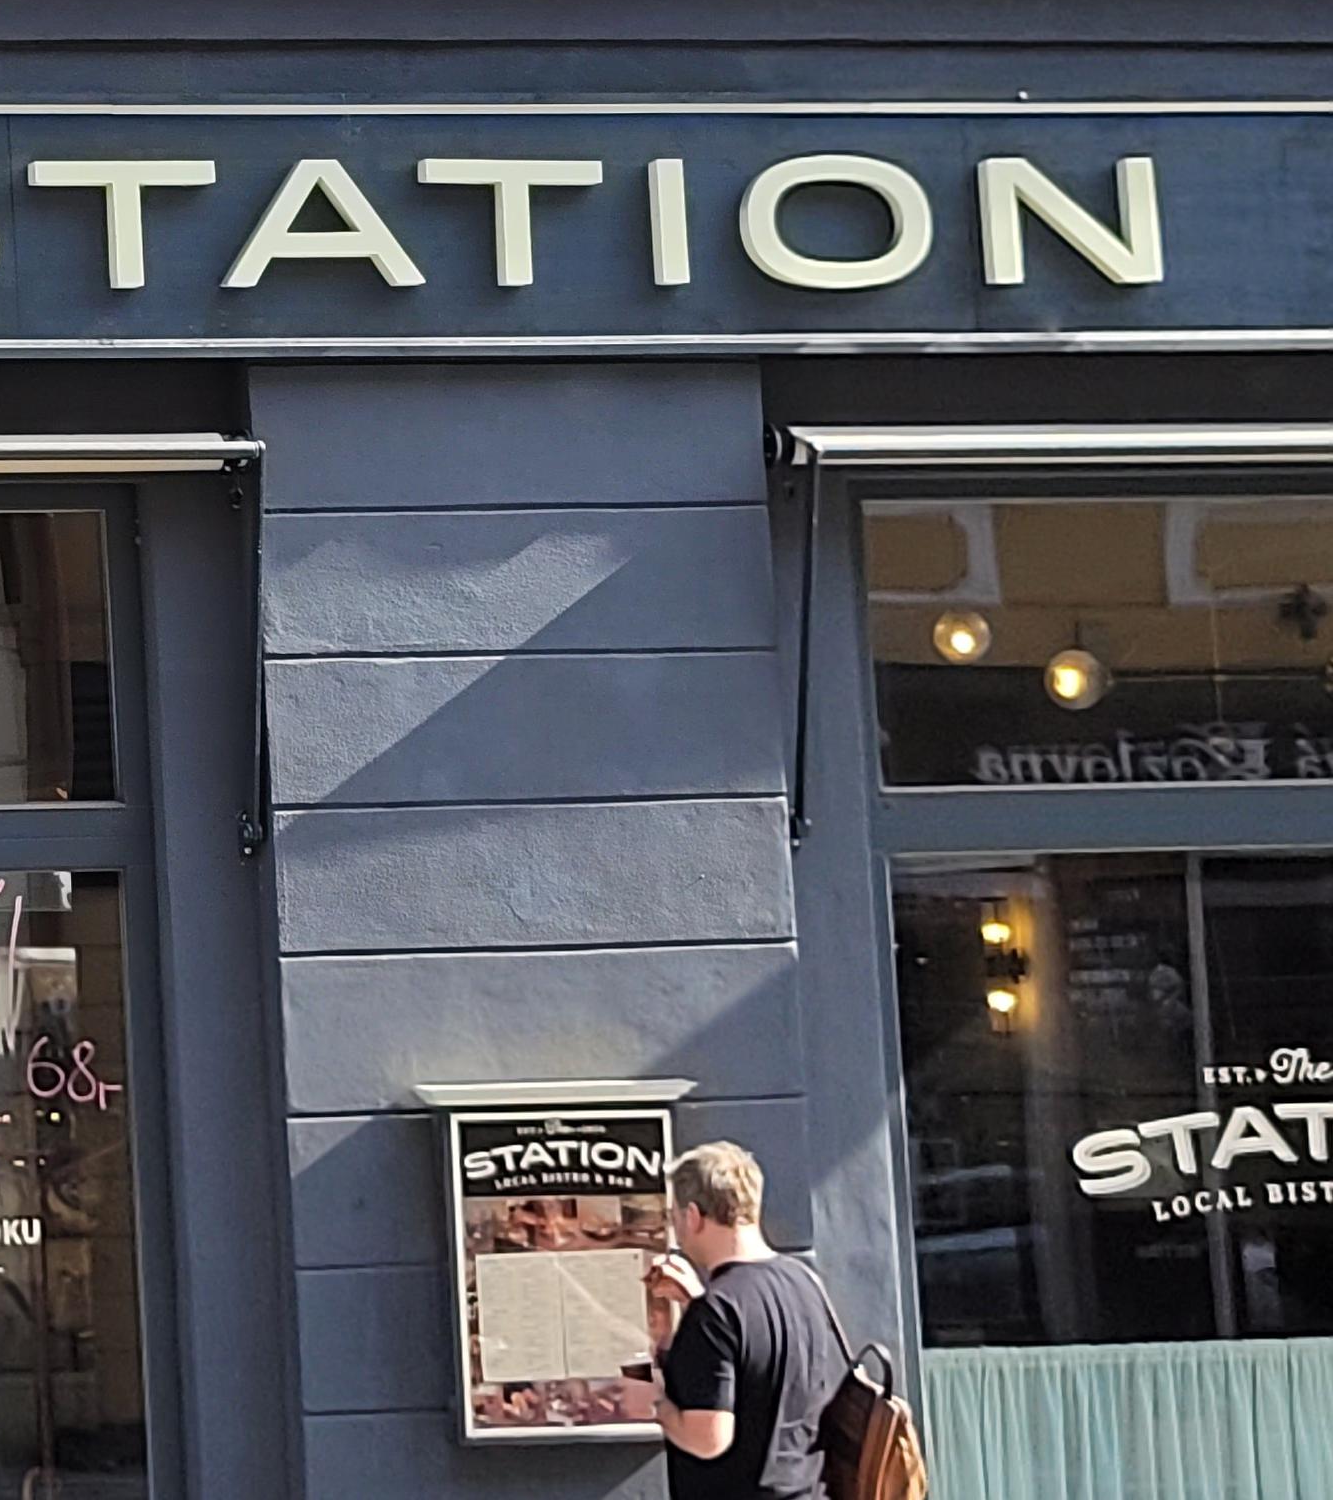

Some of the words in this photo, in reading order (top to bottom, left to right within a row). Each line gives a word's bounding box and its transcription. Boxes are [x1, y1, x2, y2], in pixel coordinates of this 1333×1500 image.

[1270, 1047, 1333, 1085] The
[463, 1140, 661, 1180] STATION
[1073, 1102, 1333, 1195] STAT
[494, 1174, 537, 1190] LOCAL
[1152, 1185, 1253, 1223] LOCAL
[1265, 1181, 1333, 1204] BIST
